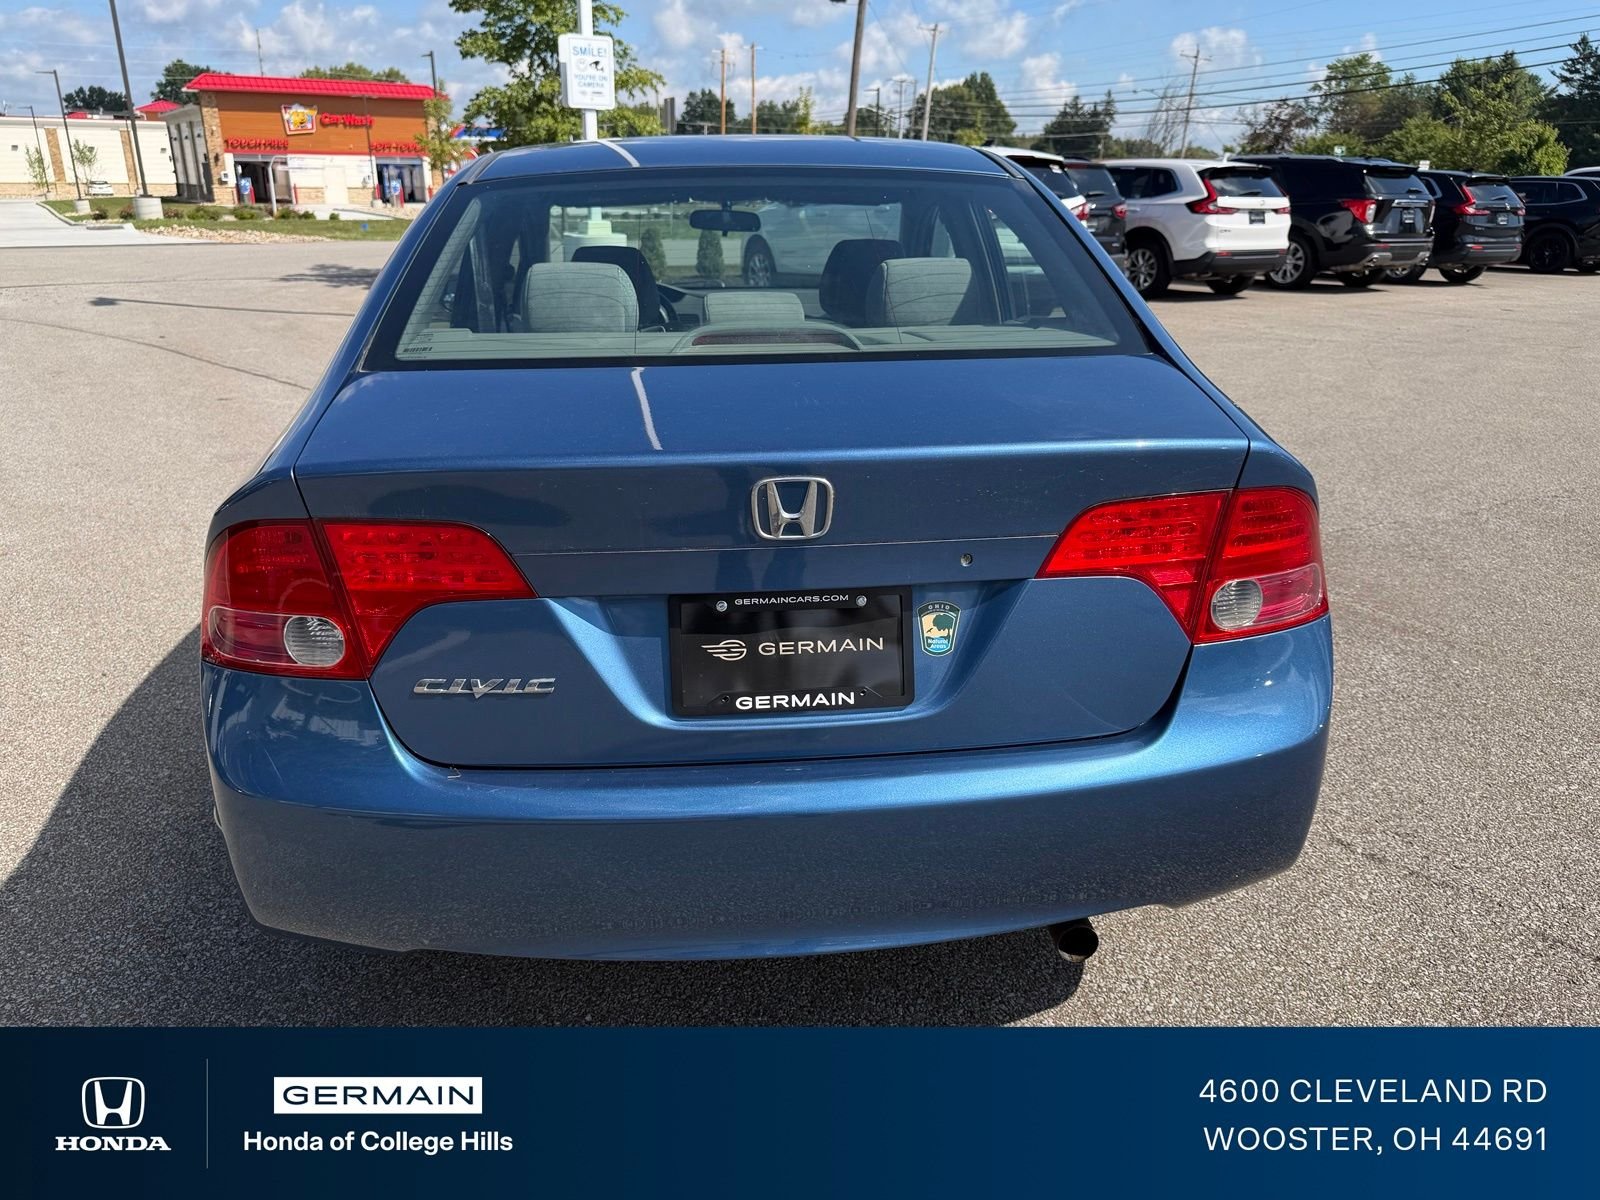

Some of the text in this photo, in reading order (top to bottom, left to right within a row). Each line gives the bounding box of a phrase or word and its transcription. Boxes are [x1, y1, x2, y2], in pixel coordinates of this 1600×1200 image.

[572, 46, 607, 57] SMILE!
[320, 112, 339, 125] Car
[734, 594, 849, 606] GERMAINCARS.COM
[758, 637, 884, 656] GERMAIN
[413, 677, 556, 698] CIVIC
[736, 691, 855, 710] GERMAIN
